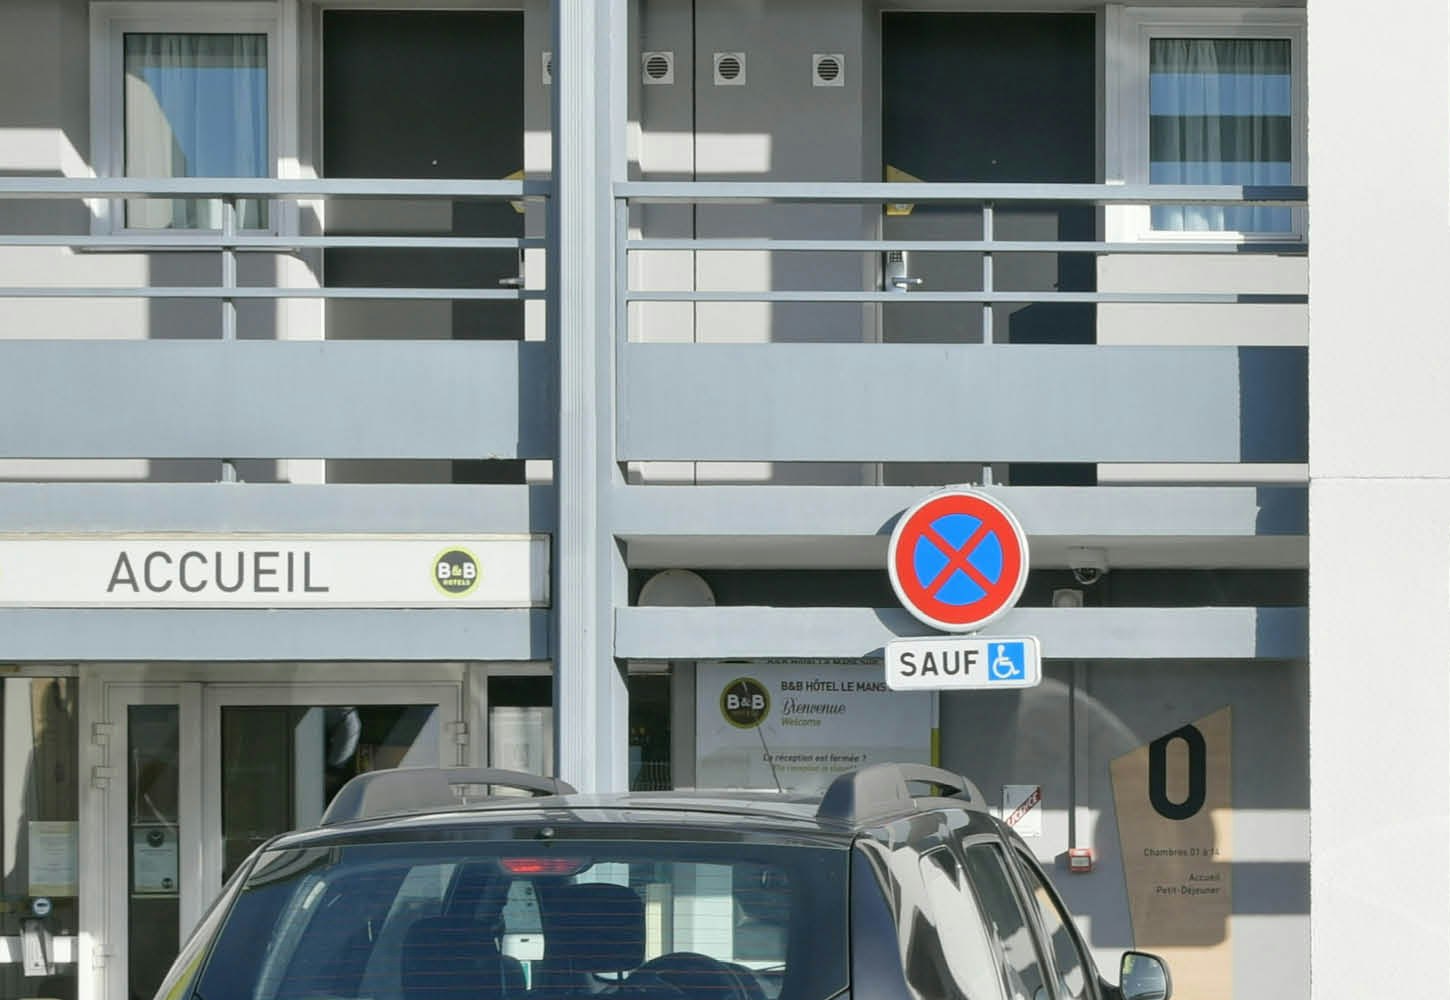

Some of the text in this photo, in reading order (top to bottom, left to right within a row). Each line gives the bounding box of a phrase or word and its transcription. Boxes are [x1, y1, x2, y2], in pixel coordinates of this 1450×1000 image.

[106, 550, 330, 593] ACCUEIL
[438, 561, 476, 578] B&B
[900, 650, 979, 677] SAUF
[781, 681, 804, 692] B&B
[806, 678, 839, 692] HÔTEL
[841, 681, 854, 692] LE
[856, 681, 887, 692] MANS
[727, 694, 764, 710] B&B
[781, 718, 822, 727] Welcome
[1149, 724, 1206, 820] 0
